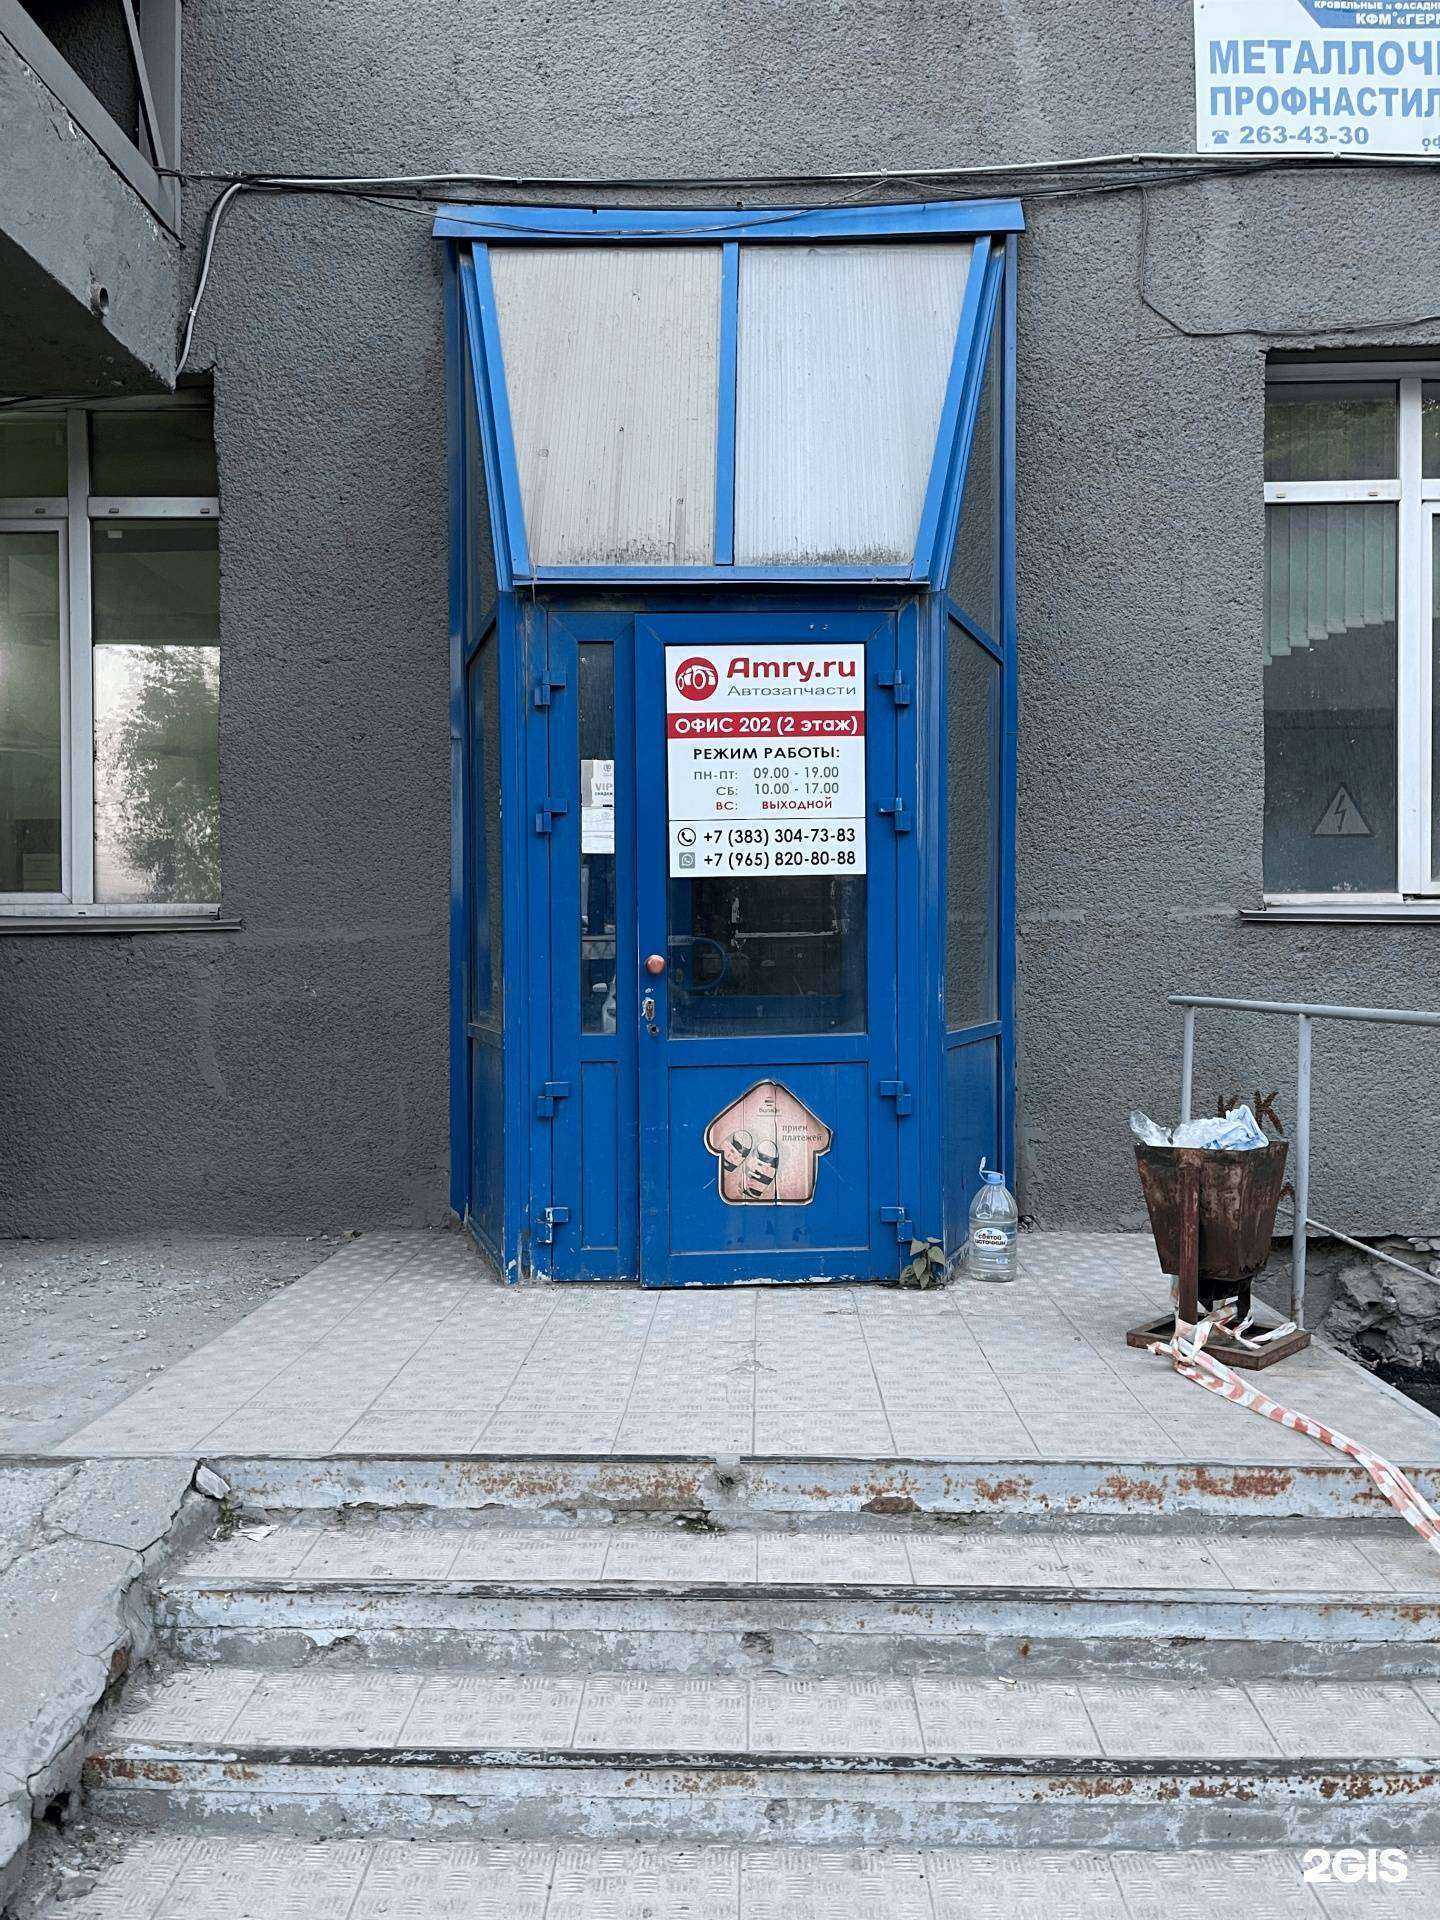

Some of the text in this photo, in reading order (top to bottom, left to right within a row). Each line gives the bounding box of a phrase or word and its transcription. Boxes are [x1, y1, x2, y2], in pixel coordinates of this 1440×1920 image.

[1314, 0, 1383, 9] КРОВЕЛЬНЫЕ
[1356, 13, 1391, 25] КФМ
[1210, 86, 1440, 117] ПРОФНАСТИЛ
[1239, 126, 1370, 145] 263-43-30
[727, 657, 856, 682] Amry.ru
[727, 685, 857, 696] Автозапчасти
[675, 715, 858, 735] ОФИС 202 (2 этаж)
[693, 746, 840, 760] РЕЖИМ РАБОТЫ:
[694, 770, 738, 780] ПН-ПТ:
[753, 767, 789, 779] 09.00
[804, 766, 839, 778] 19.00
[716, 786, 738, 796] СБ:
[754, 783, 789, 795] 10.00
[804, 782, 839, 794] 17.00
[716, 797, 832, 811] ВС: ВЫХОДНОЙ
[704, 828, 856, 847] +7 (383) 304-73-83
[704, 851, 856, 870] +7 (965) 820-80-88
